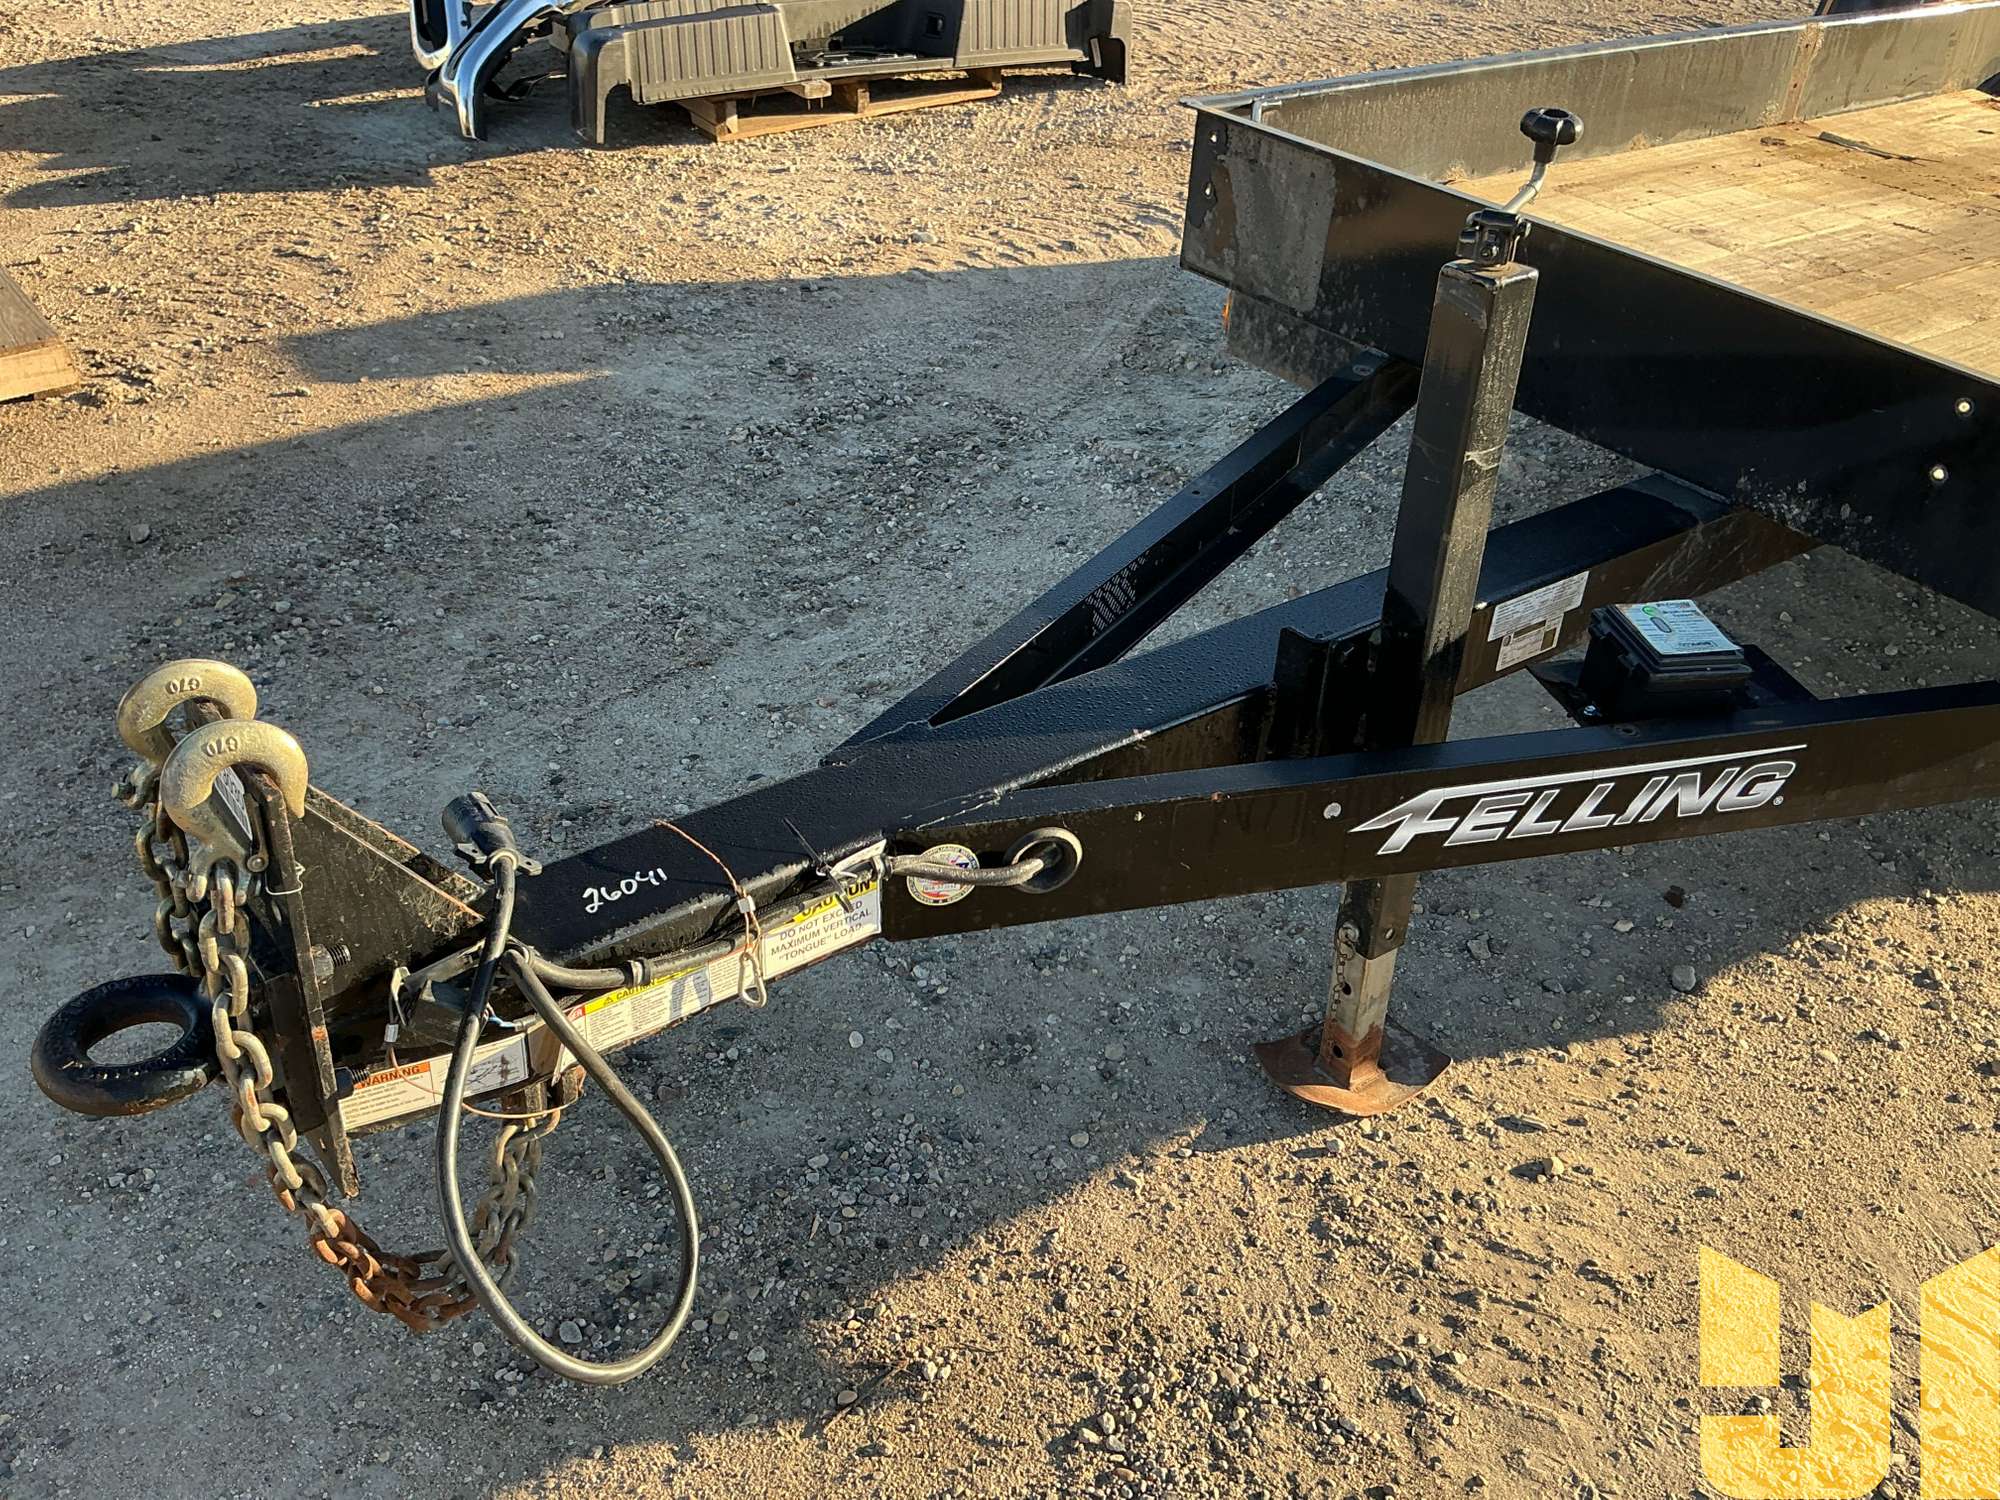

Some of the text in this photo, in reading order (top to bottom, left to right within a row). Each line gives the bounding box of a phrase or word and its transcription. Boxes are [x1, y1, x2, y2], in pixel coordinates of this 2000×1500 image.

[1349, 744, 1808, 855] FELLING
[582, 867, 668, 914] 26041
[801, 880, 871, 917] CAUON
[771, 908, 871, 956] MAXIMUM VERTICAL
[780, 900, 863, 941] DO NOT EXCD
[616, 979, 657, 1001] CAUTIN
[361, 1064, 421, 1089] WARNNG
